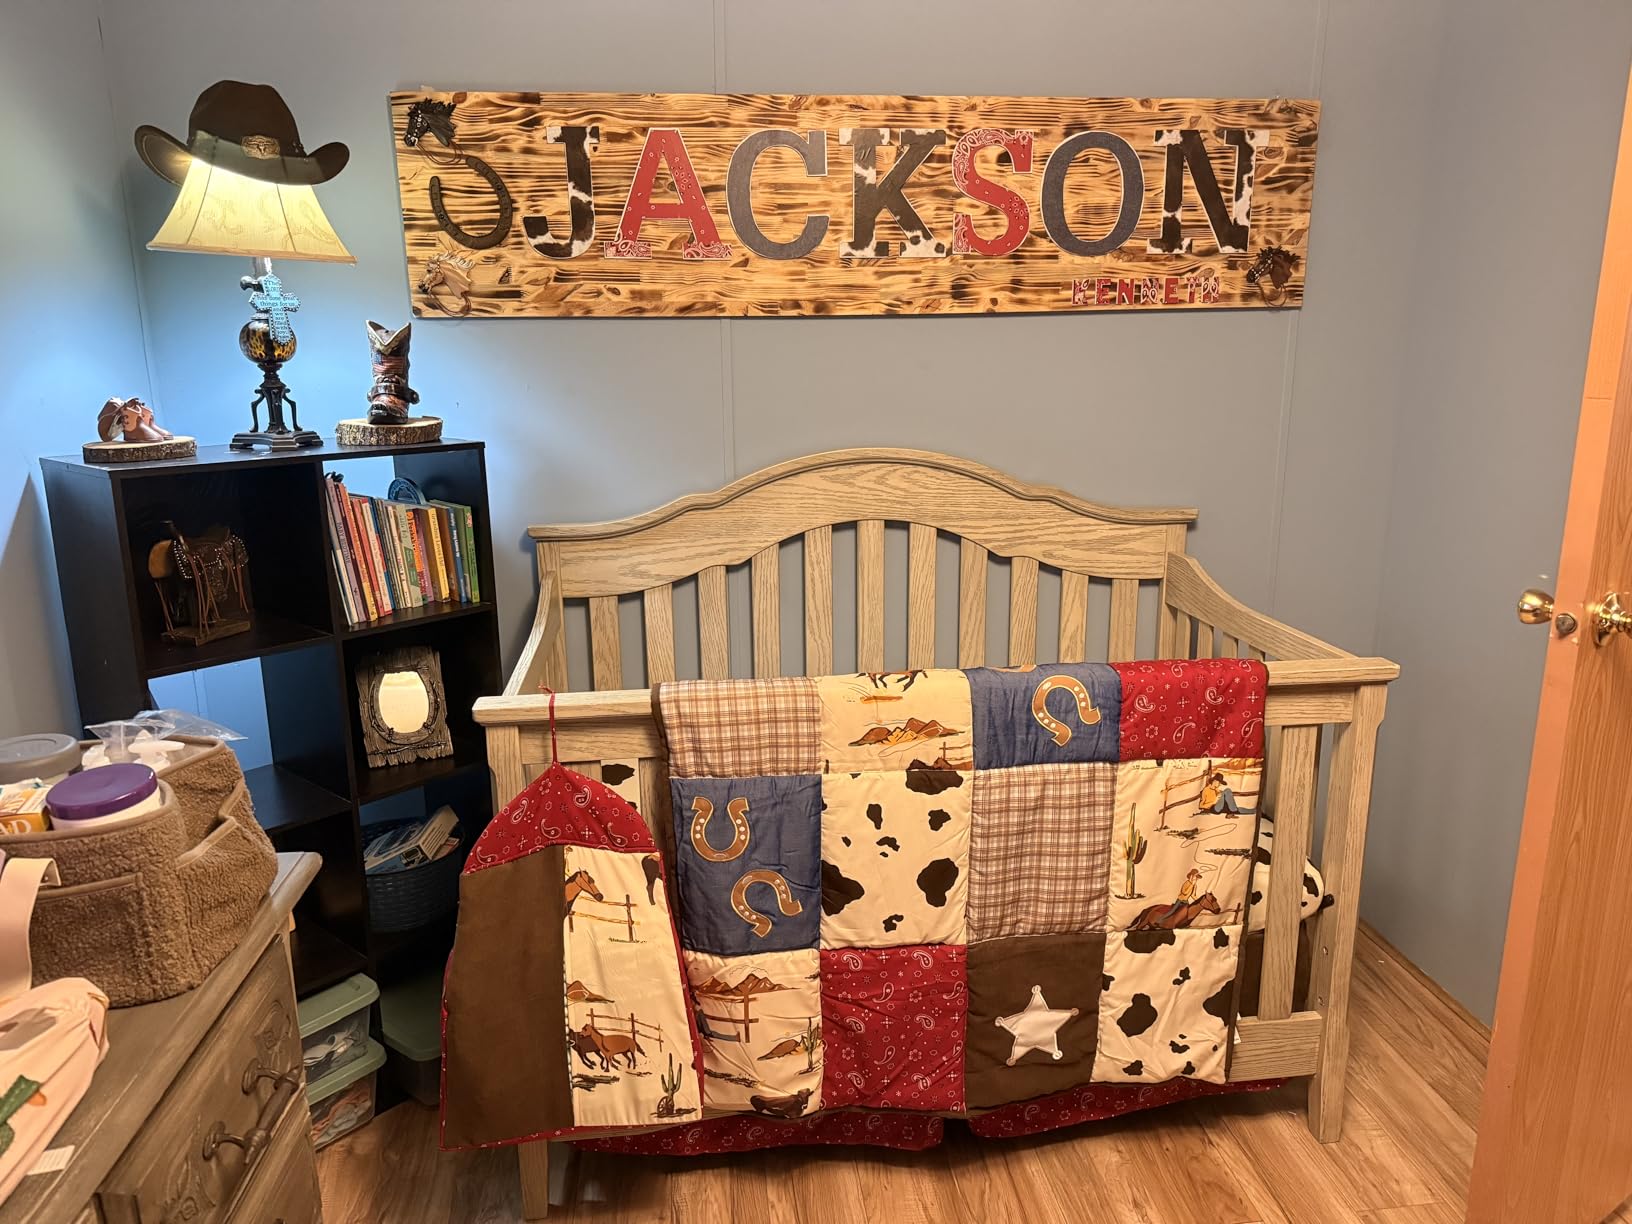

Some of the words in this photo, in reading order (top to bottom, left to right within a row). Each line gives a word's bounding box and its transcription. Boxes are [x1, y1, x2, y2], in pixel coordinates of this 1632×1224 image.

[523, 126, 1270, 259] JACKSON
[1071, 276, 1221, 306] KENNETH
[430, 512, 439, 539] Grandma
